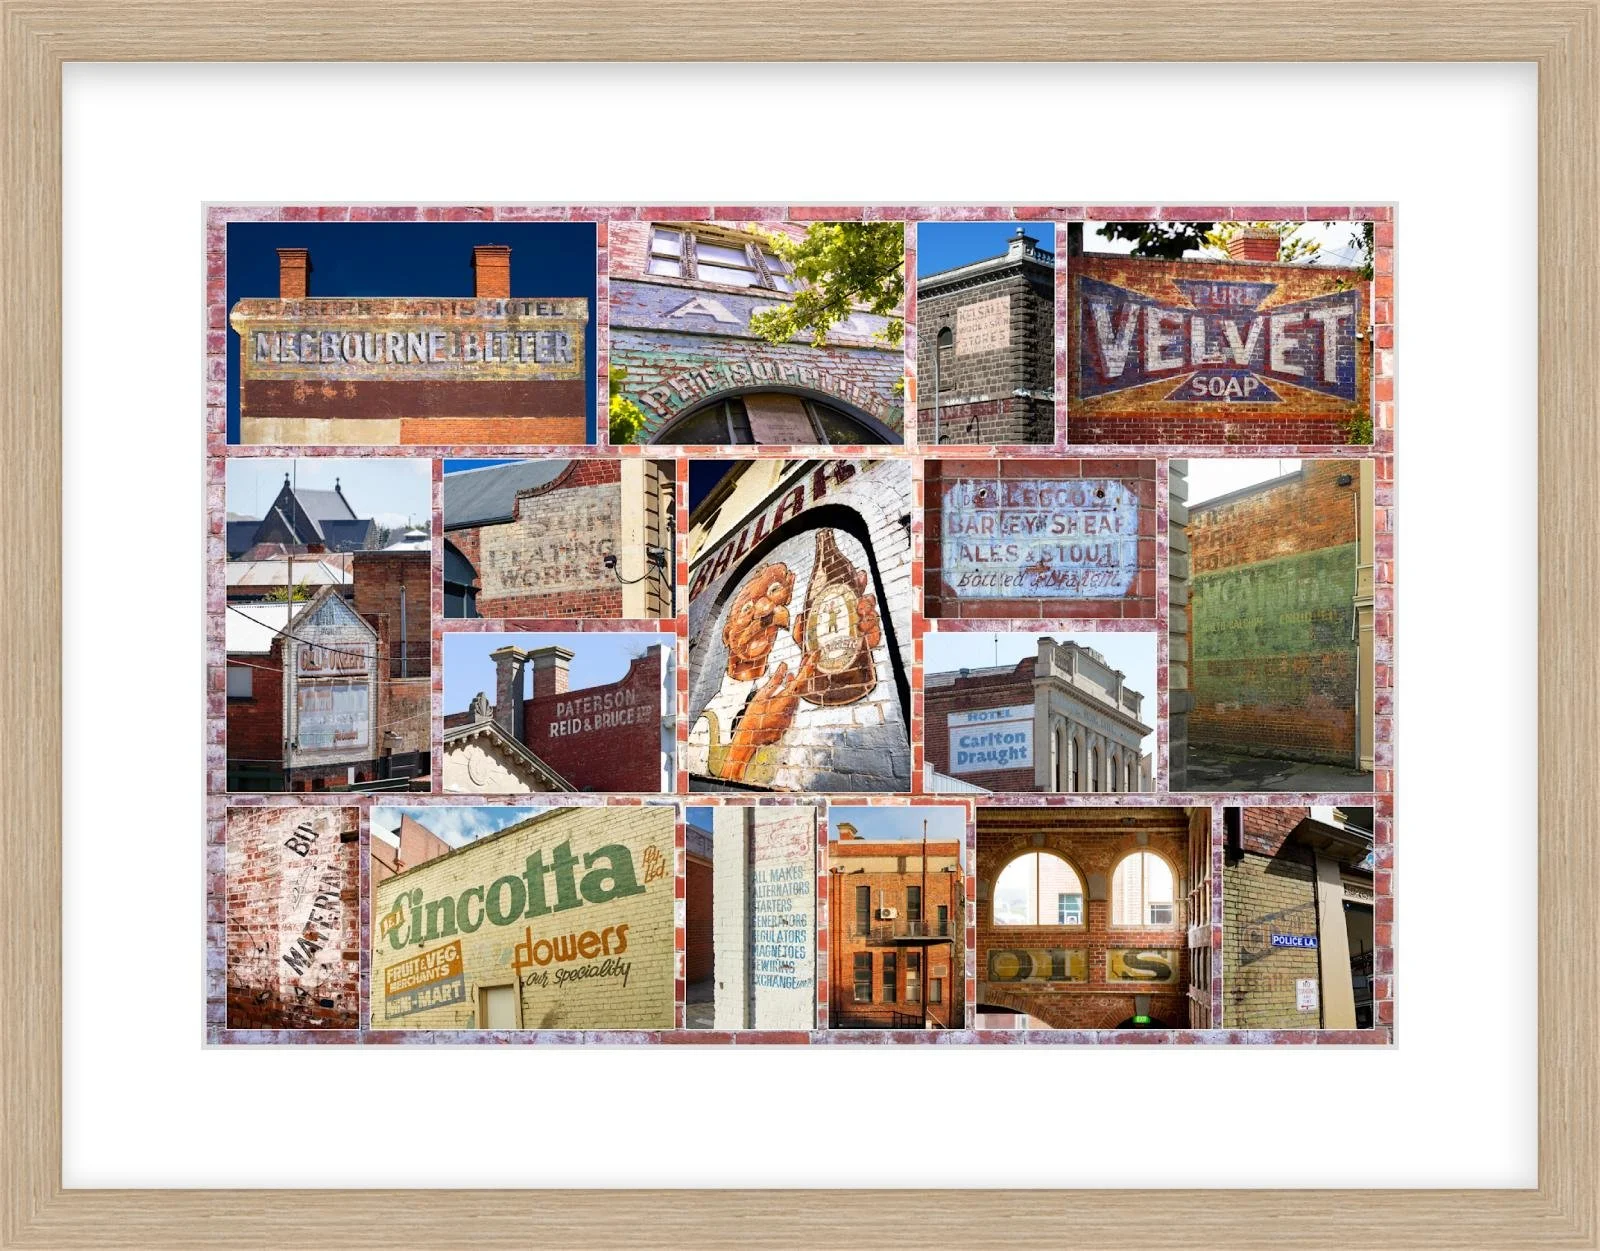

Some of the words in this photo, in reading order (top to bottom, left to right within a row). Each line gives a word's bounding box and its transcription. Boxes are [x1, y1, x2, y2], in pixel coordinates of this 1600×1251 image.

[463, 331, 573, 364] BITTER
[1090, 303, 1353, 383] VELVET
[1192, 375, 1260, 398] SOAP
[948, 512, 1037, 536] BARLEY
[959, 544, 1020, 563] ALES
[556, 687, 636, 718] PATERSON
[550, 717, 582, 738] REID
[584, 718, 592, 732] &
[594, 707, 634, 730] BRUCE
[967, 708, 1012, 722] HOTEL
[959, 730, 1026, 749] Carlton
[957, 746, 1028, 766] Draught
[752, 870, 768, 884] ALL
[770, 865, 804, 882] MAKES
[390, 840, 646, 950] Cincotta
[752, 881, 810, 899] ALTERNATORS
[752, 897, 793, 913] STARTERS
[752, 913, 807, 929] GENERATORS
[752, 929, 807, 944] REGULATORS
[1273, 935, 1303, 946] POLICE
[752, 944, 806, 960] MAGNETOES
[386, 958, 420, 984] FRUIT
[426, 945, 460, 969] VEG.
[553, 957, 632, 988] speciality
[752, 974, 797, 990] EXCHANGE
